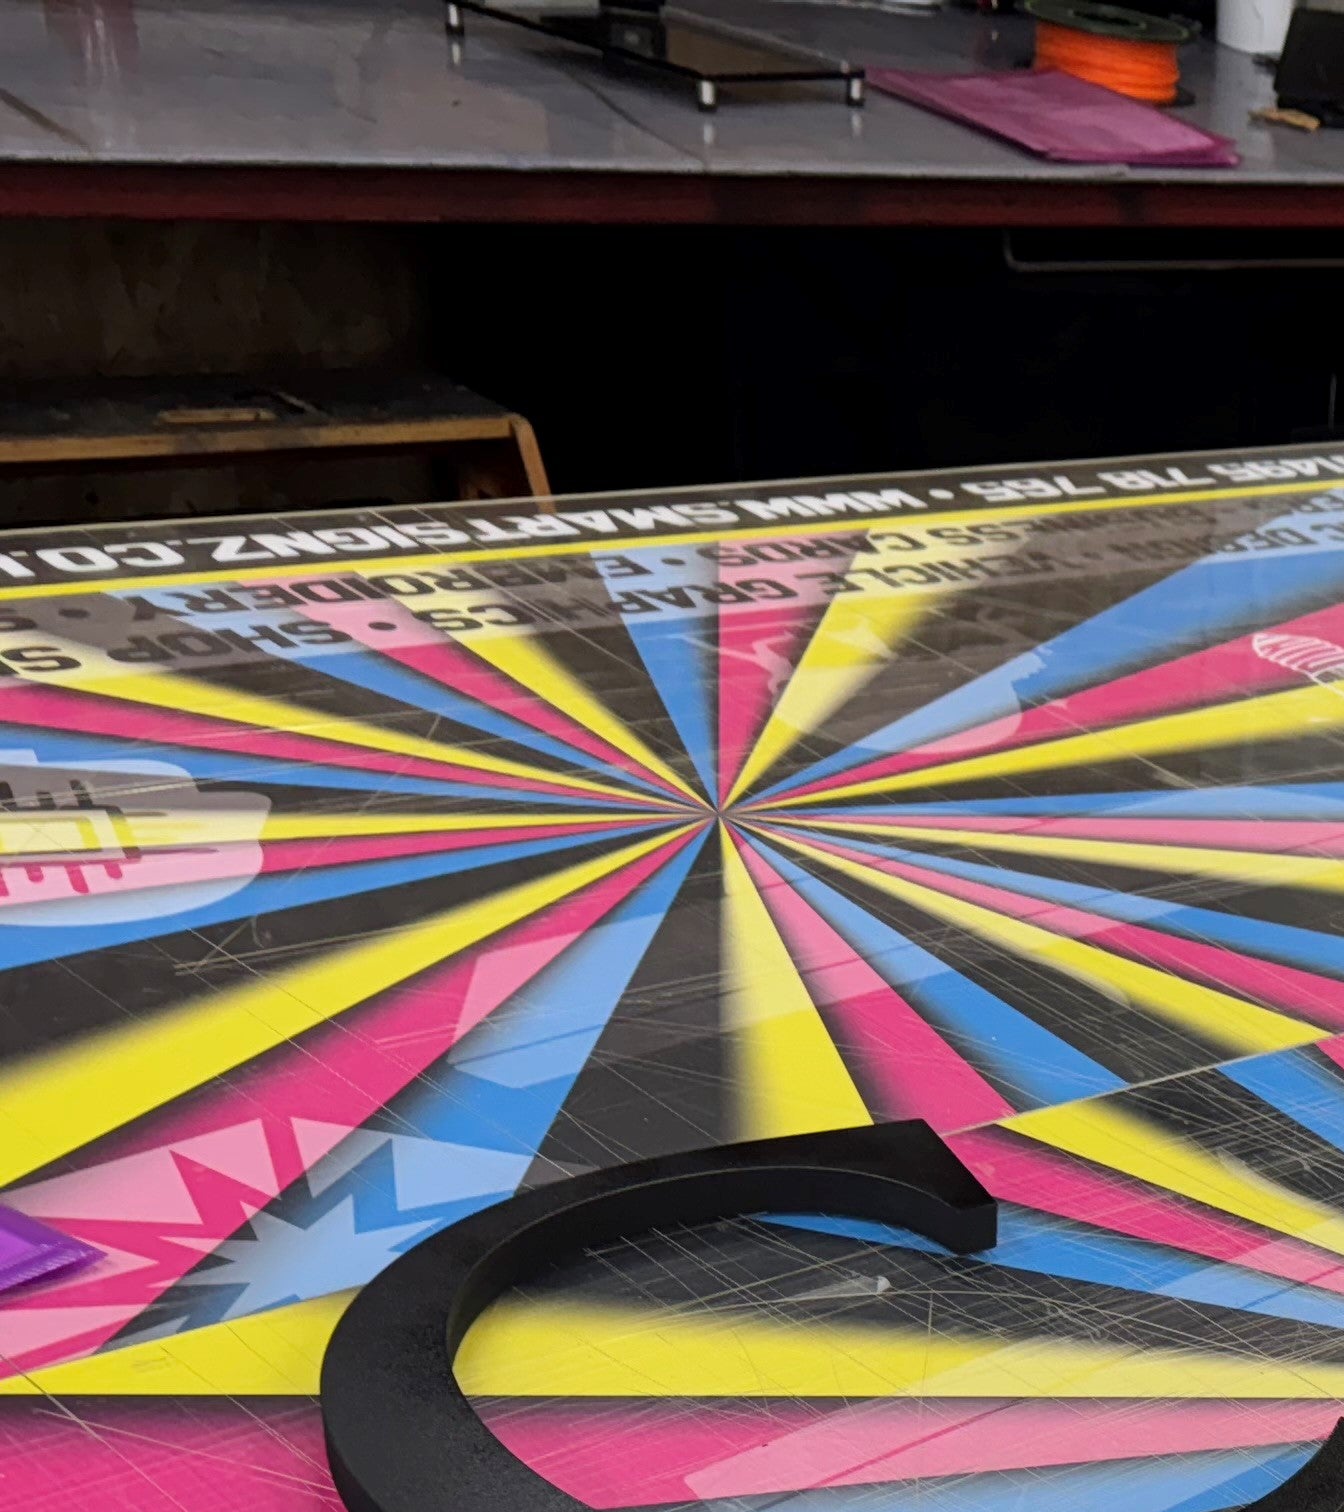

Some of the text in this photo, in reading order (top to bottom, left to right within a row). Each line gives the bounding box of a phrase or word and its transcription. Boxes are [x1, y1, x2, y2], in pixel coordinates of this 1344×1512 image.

[960, 475, 1105, 503] 765
[1098, 466, 1217, 491] 718
[698, 526, 927, 568] CARDS
[121, 553, 655, 621] EMBROIDERY
[796, 550, 1081, 596] VEHICLE
[107, 620, 354, 663] SHOP
